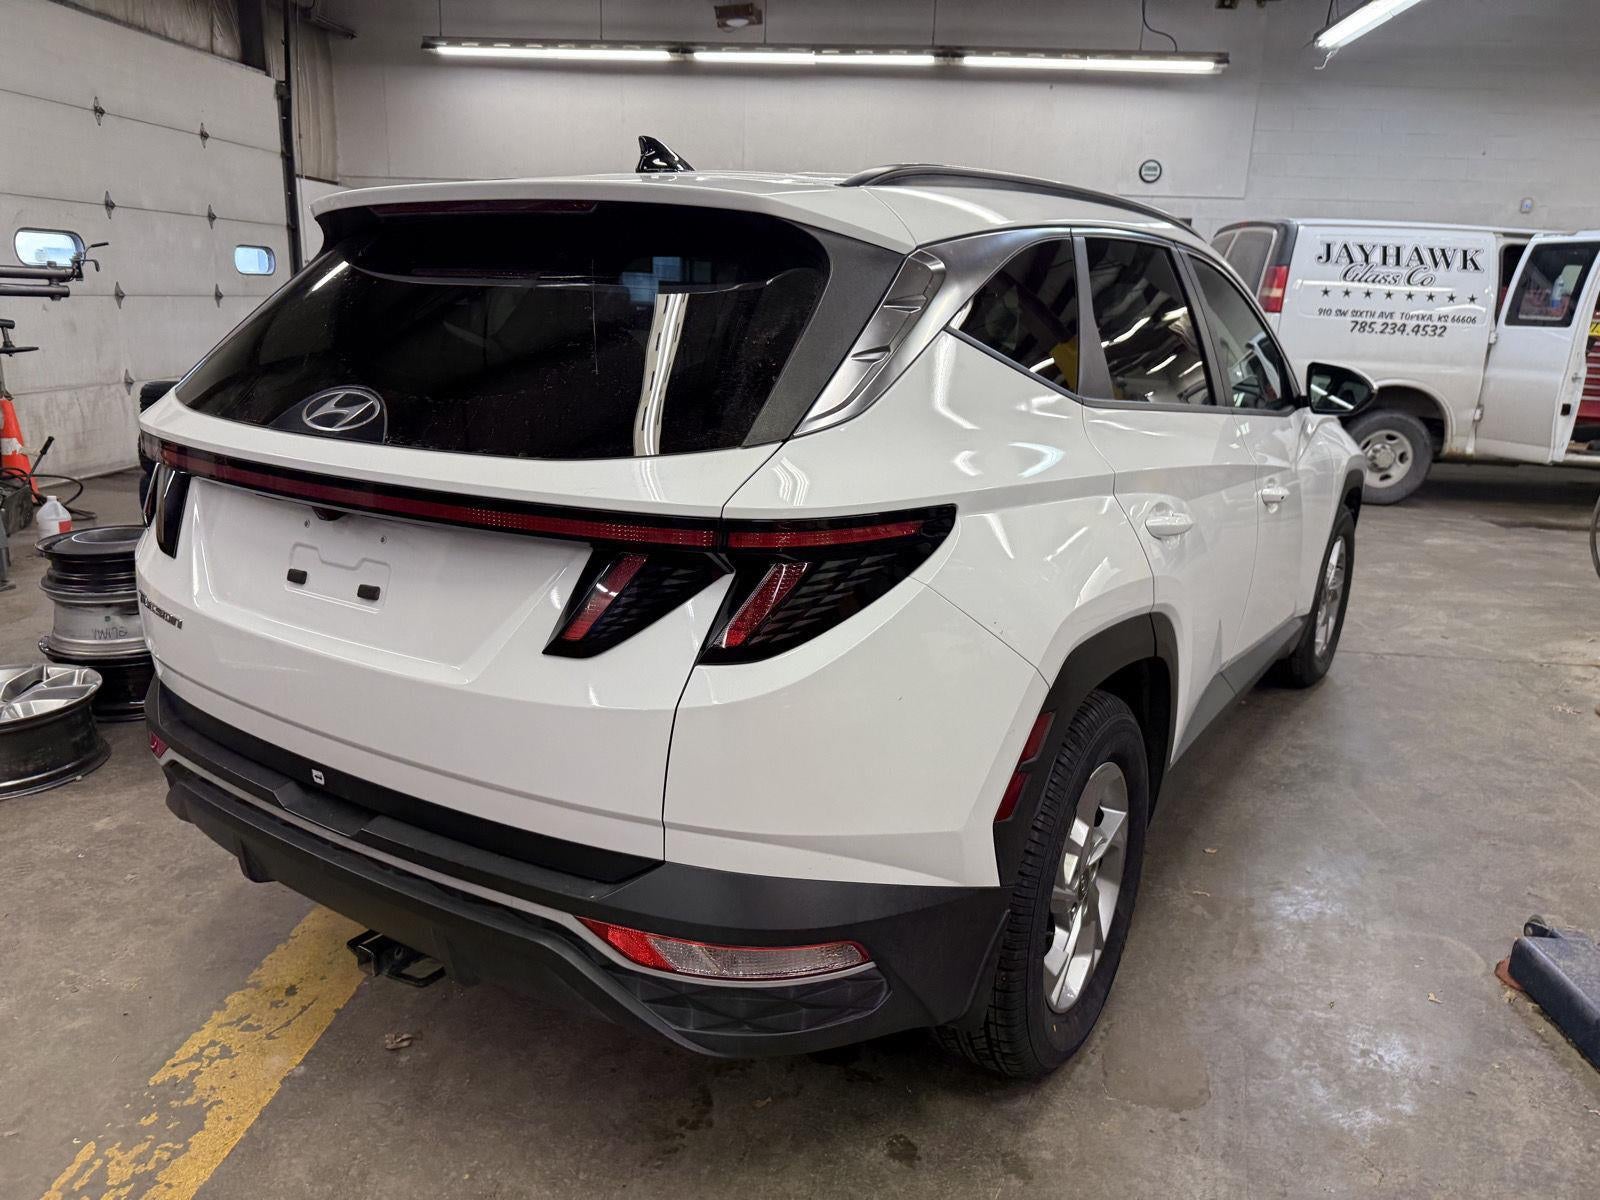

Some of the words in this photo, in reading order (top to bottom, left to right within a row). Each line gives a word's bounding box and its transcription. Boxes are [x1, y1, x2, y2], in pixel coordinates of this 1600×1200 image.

[1316, 241, 1484, 272] JAYHAWK
[1341, 263, 1401, 285] Glass
[1405, 266, 1435, 287] Co
[1318, 308, 1332, 317] 910
[1335, 309, 1349, 317] SW
[1350, 309, 1376, 318] SIXTH
[1378, 311, 1395, 319] AVE
[1437, 313, 1449, 322] KS
[1450, 315, 1477, 324] 66606
[1350, 320, 1447, 337] 785.234.4532
[140, 591, 183, 630] TUCSON
